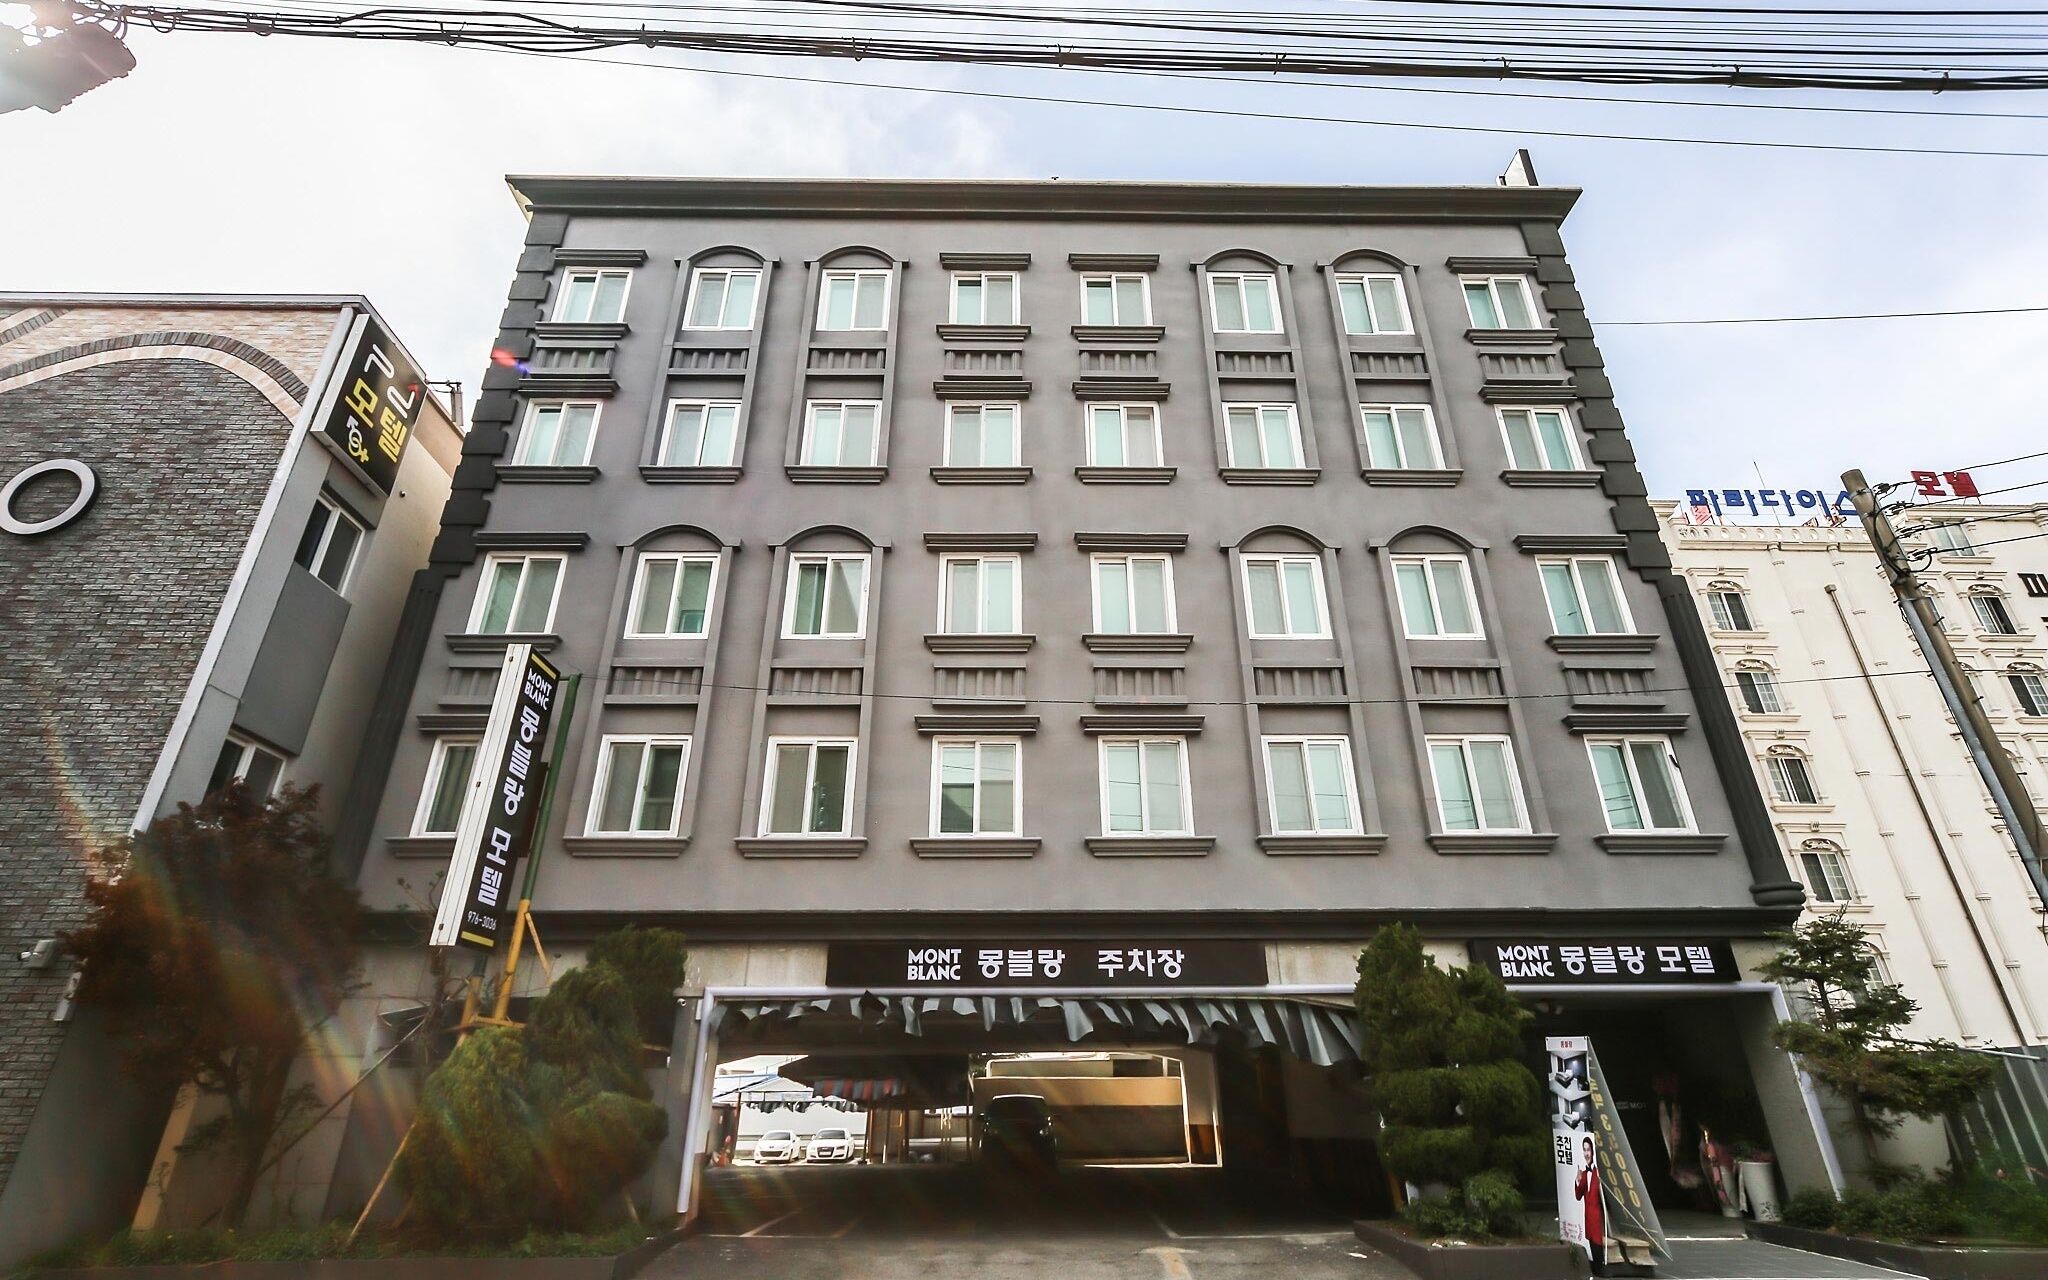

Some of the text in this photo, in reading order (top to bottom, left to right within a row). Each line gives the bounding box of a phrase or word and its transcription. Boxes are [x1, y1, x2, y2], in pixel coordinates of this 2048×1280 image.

[345, 377, 408, 463] 모텔
[527, 667, 553, 697] MONT
[524, 683, 550, 711] BLANC
[477, 705, 541, 907] 몽블랑 모텔
[467, 911, 497, 931] 976-3036
[907, 948, 961, 965] MONT
[978, 948, 1185, 979] 몽블랑 주차장
[1496, 945, 1550, 962] MONT
[1559, 946, 1715, 975] 몽블랑 모텔
[907, 965, 961, 981] BLANC
[1500, 961, 1555, 978] BLANC
[1556, 1135, 1572, 1150] 추천
[1557, 1150, 1573, 1165] 모텔
